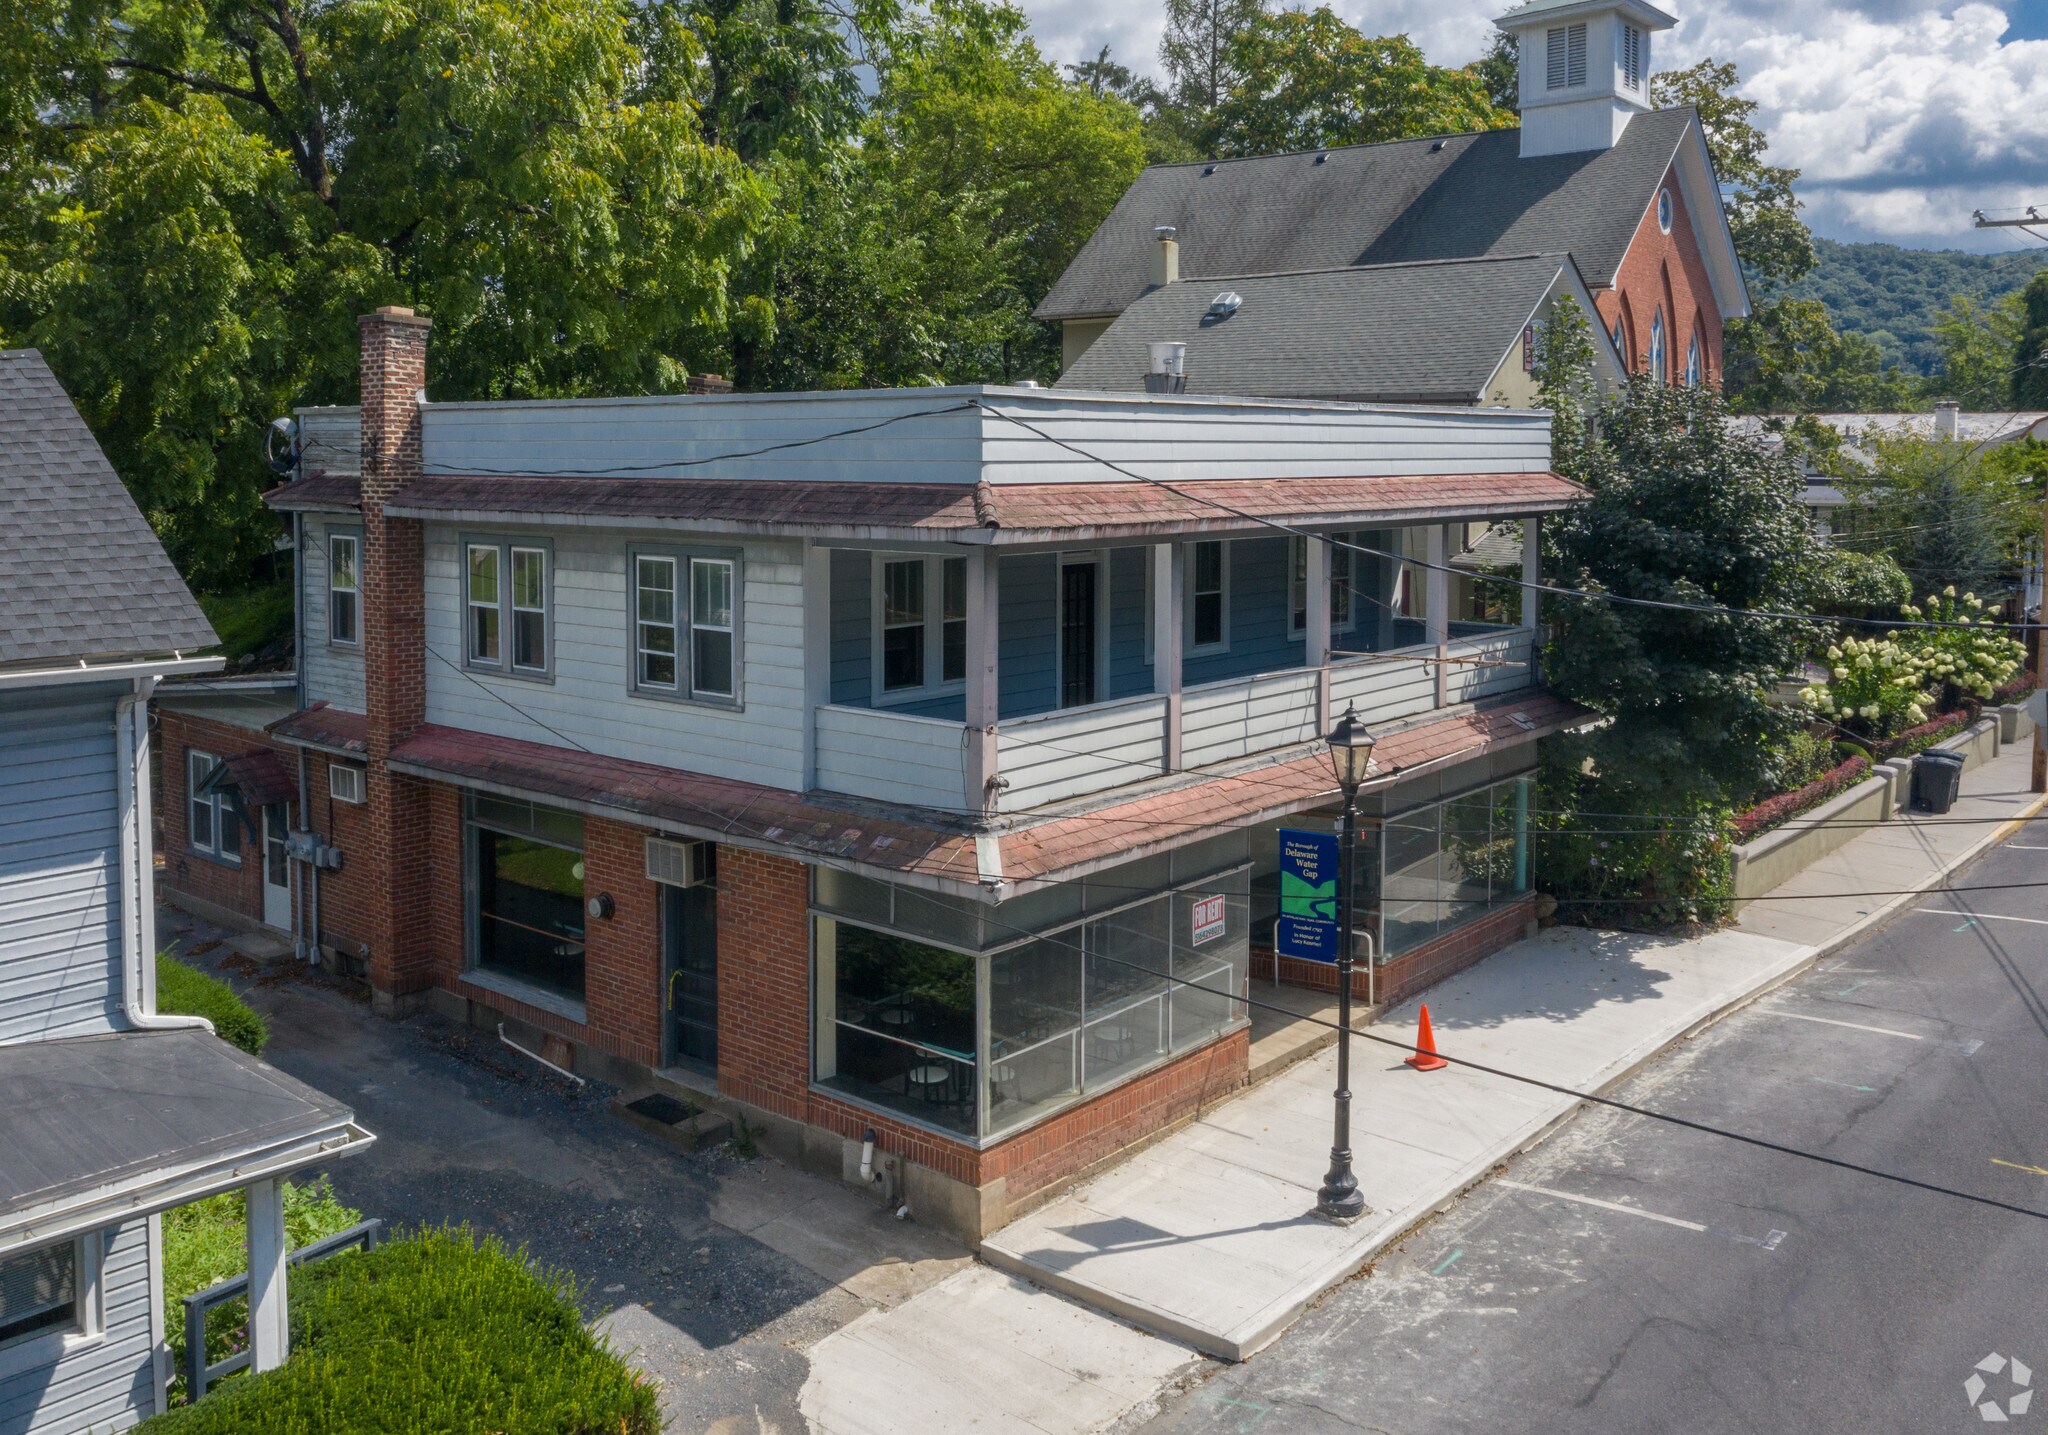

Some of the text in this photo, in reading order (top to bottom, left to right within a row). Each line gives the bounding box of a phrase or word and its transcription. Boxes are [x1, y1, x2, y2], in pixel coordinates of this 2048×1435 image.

[1285, 848, 1318, 859] Delaware
[1296, 859, 1318, 868] Water
[1303, 869, 1318, 879] Gap
[1195, 898, 1223, 928] FOR RENT
